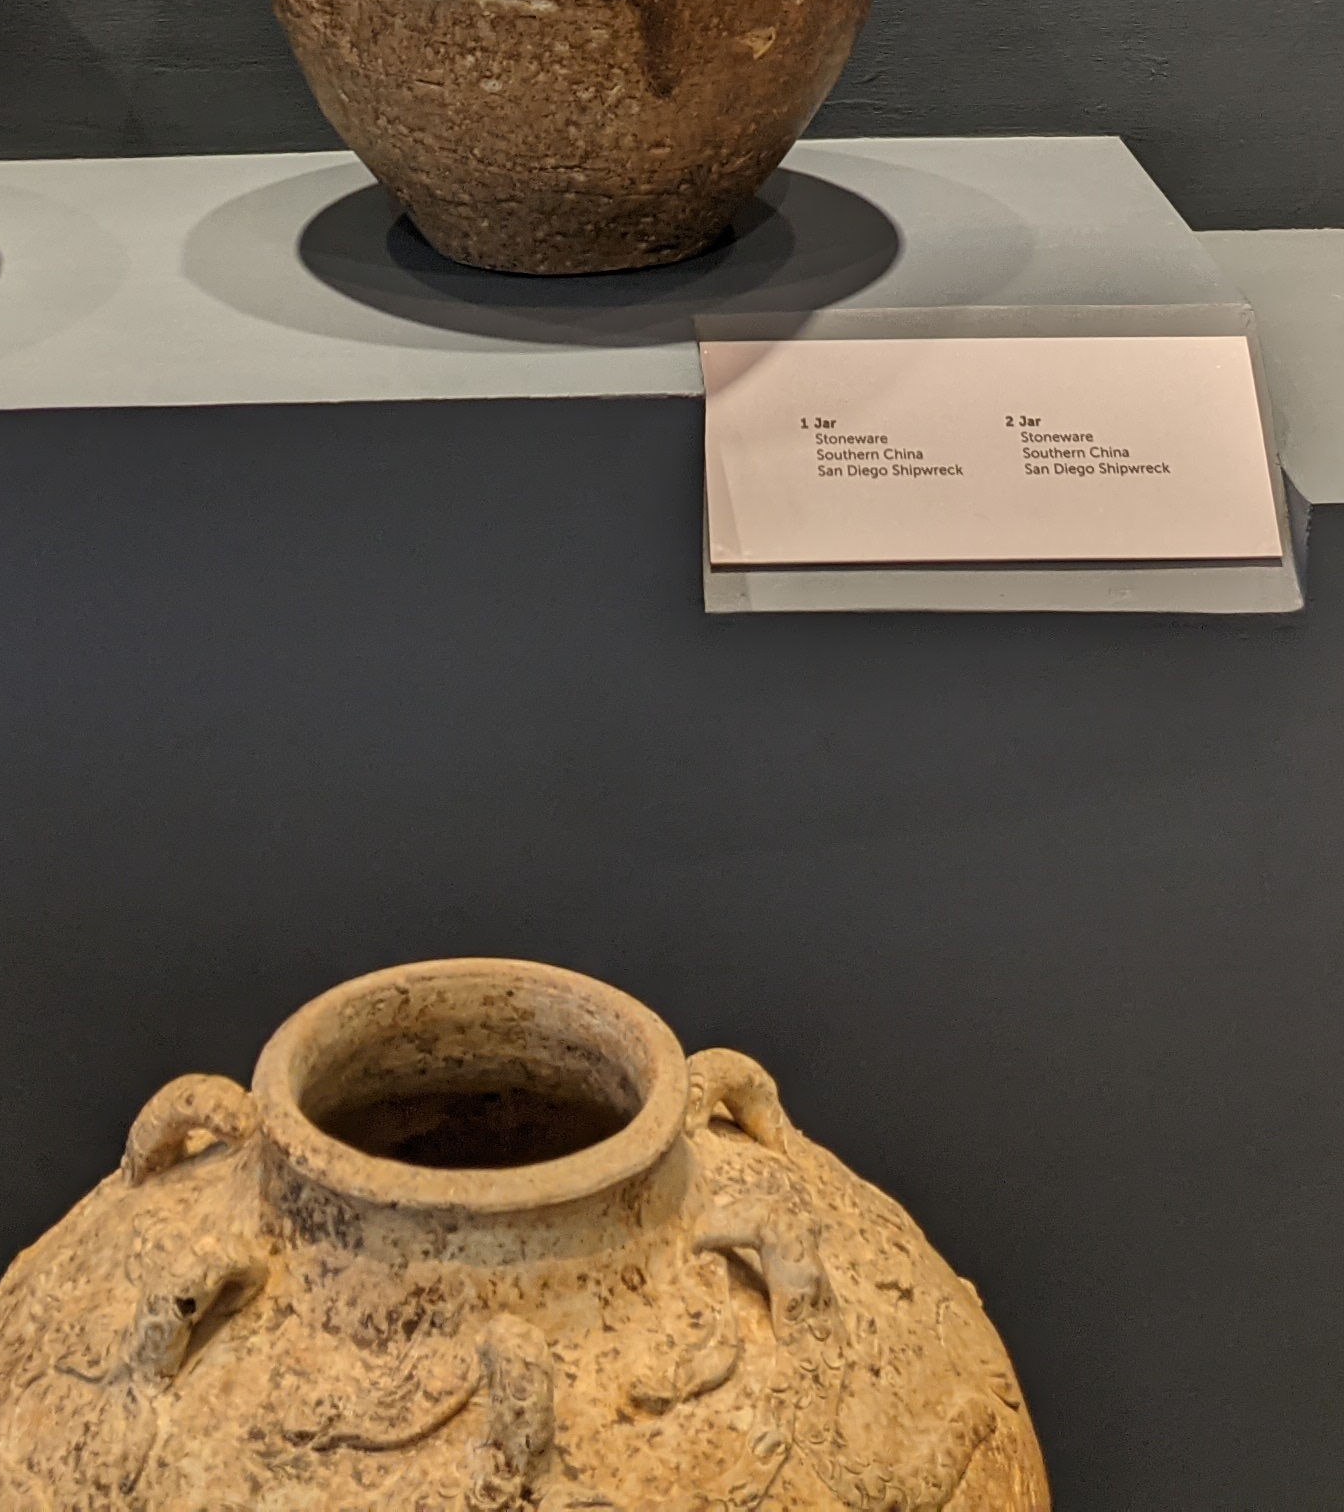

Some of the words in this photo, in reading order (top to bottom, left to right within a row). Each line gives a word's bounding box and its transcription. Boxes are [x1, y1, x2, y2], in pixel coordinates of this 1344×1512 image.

[800, 417, 809, 429] 1
[814, 417, 837, 429] Jar
[1005, 416, 1014, 427] 2
[1019, 415, 1042, 427] Jar
[815, 433, 889, 445] Stoneware
[1020, 431, 1094, 443] Stoneware
[816, 448, 880, 461] Southern
[883, 448, 924, 460] China
[1022, 447, 1086, 459] Southern
[1089, 446, 1130, 458] China
[818, 464, 843, 477] San
[847, 464, 888, 479] Diego
[892, 463, 964, 478] Shipwreck
[1024, 463, 1050, 475] San
[1054, 462, 1095, 477] Diego
[1098, 462, 1171, 476] Shipwreck
